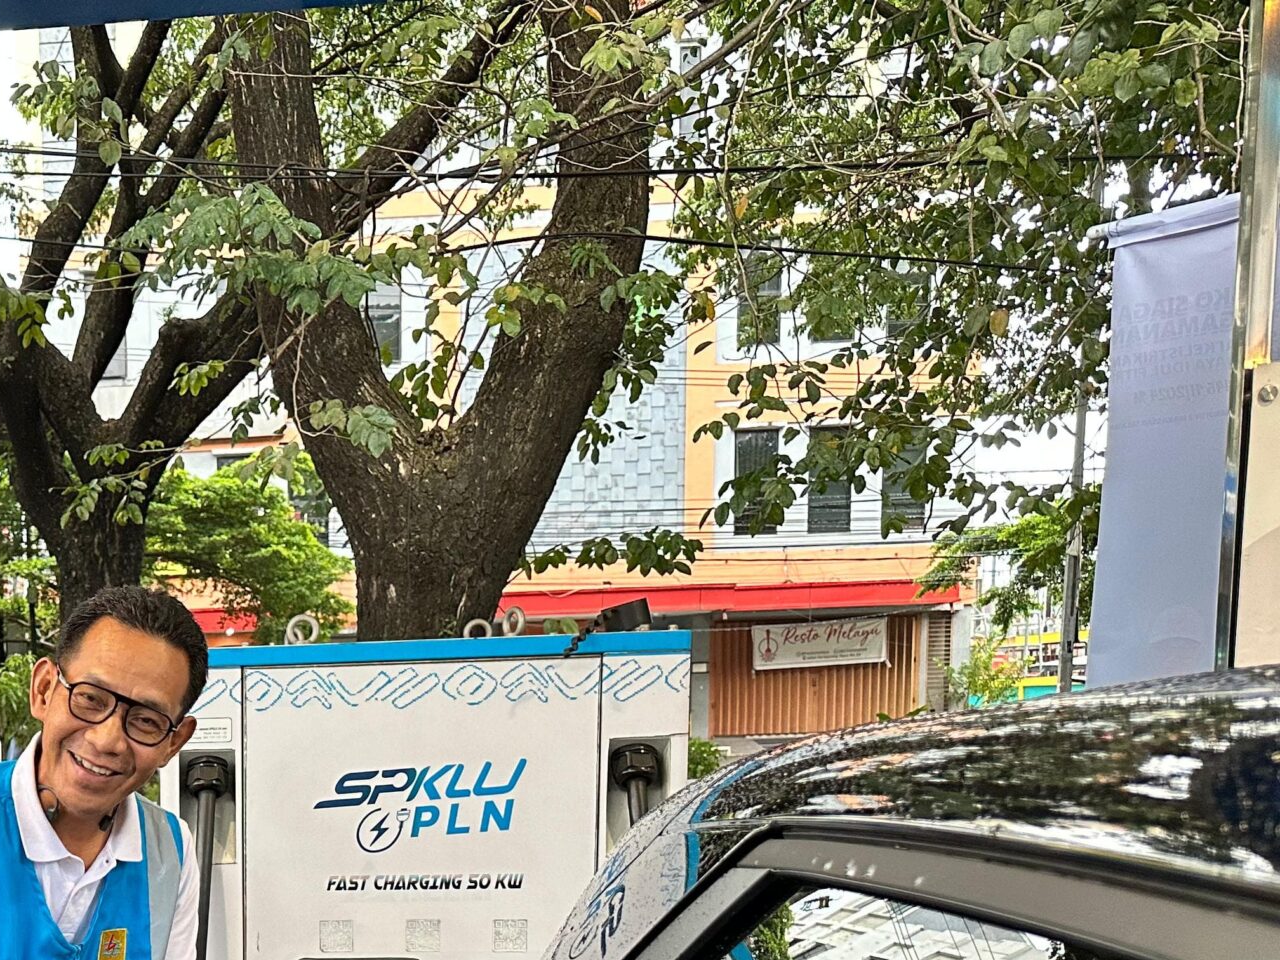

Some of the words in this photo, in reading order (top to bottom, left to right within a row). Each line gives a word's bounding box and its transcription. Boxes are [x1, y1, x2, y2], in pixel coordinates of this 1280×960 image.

[782, 626, 821, 645] Resto
[313, 758, 527, 809] SPKLU
[411, 799, 515, 838] PLN
[327, 875, 370, 891] FAST
[374, 874, 463, 891] CHARGING
[495, 873, 524, 889] KW
